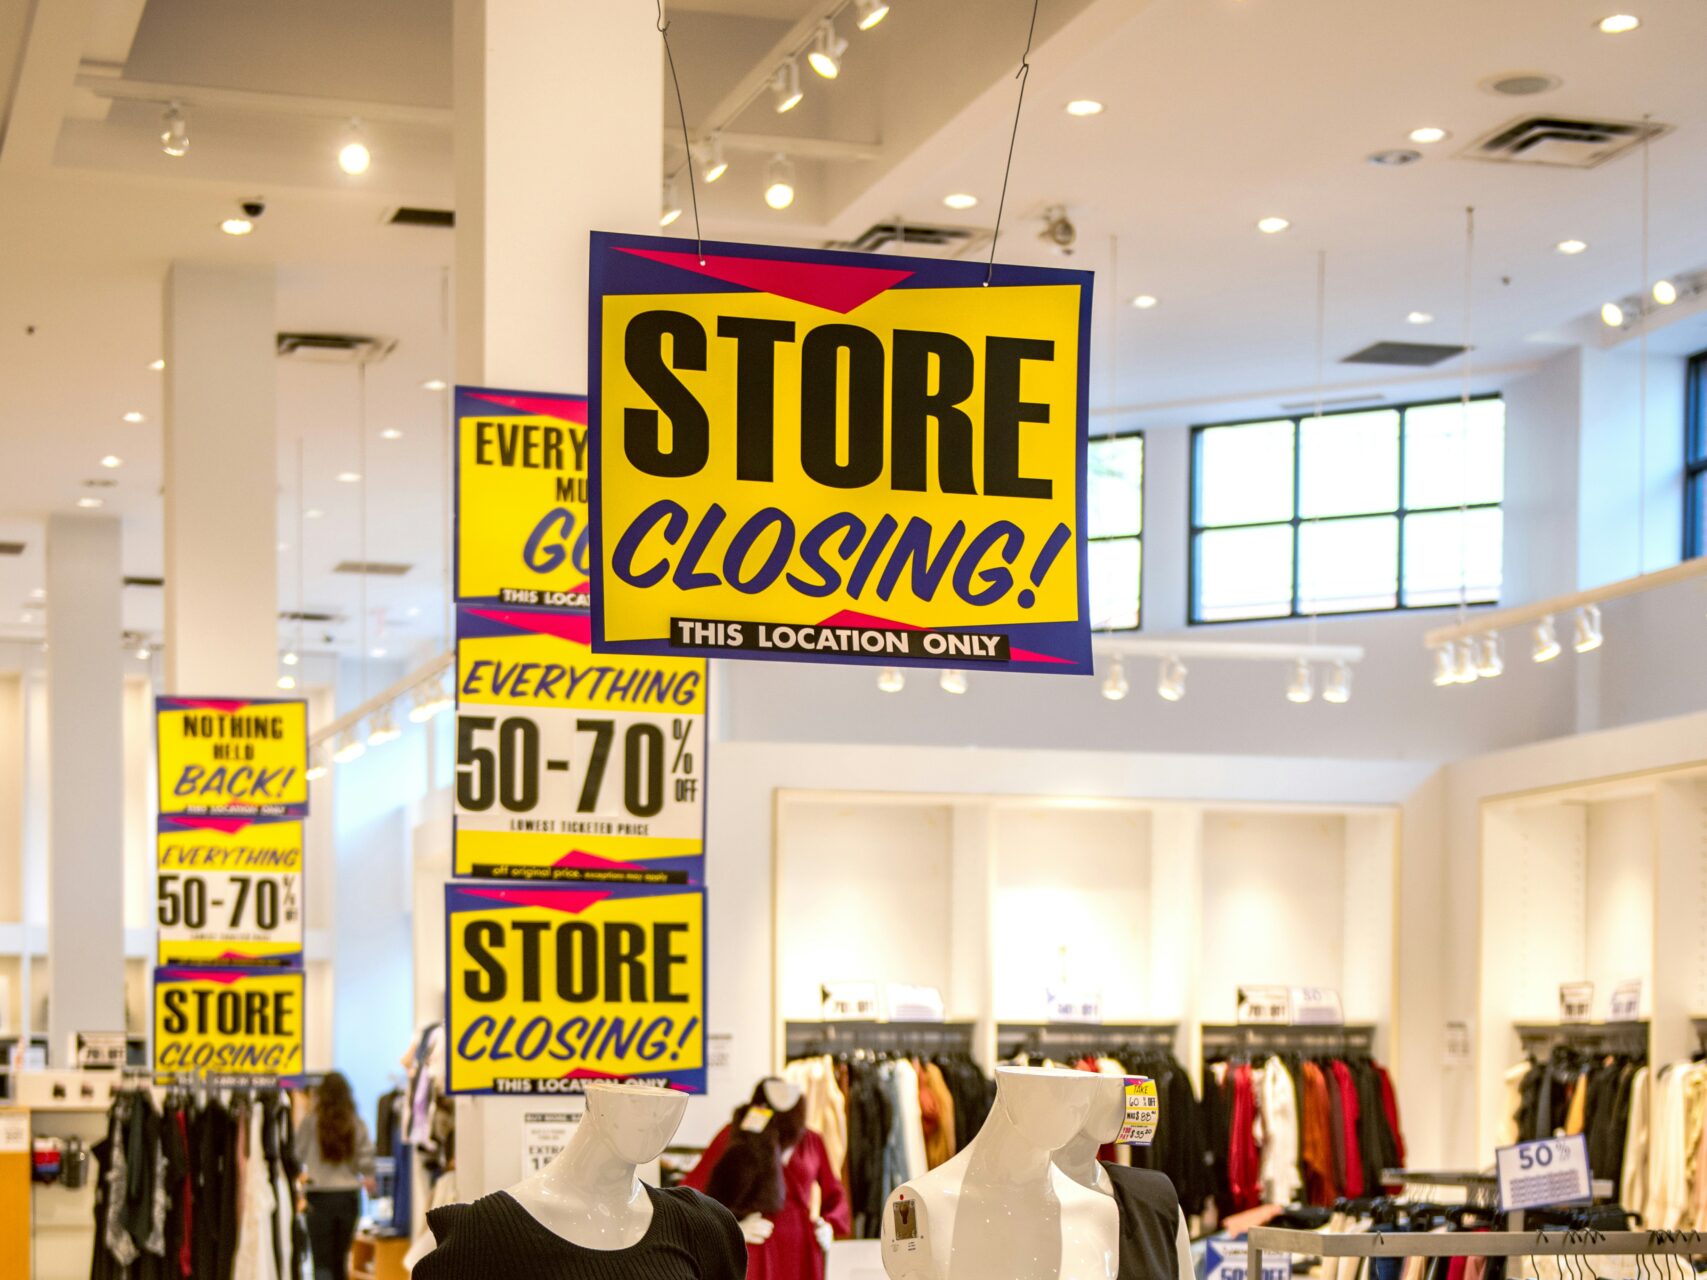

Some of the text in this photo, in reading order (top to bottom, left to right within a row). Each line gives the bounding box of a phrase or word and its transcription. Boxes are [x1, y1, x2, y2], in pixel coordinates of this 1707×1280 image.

[624, 309, 1055, 500] STORE
[611, 499, 1072, 610] CLOSING!
[503, 589, 538, 604] THIS
[678, 621, 1000, 657] THIS LOCATION ONLY
[462, 660, 700, 706] EVERYTHING
[183, 715, 283, 740] NOTHING
[173, 764, 296, 798] BACK!
[675, 778, 697, 802] OFF
[511, 819, 649, 836] LOWEST TICKETED PRICE
[162, 845, 299, 868] EVERYTHING
[511, 866, 551, 879] original
[464, 920, 688, 1003] STORE
[163, 988, 294, 1036] STORE
[457, 1015, 699, 1061] CLOSING!
[159, 1042, 300, 1068] CLOSING!
[496, 1079, 531, 1092] THIS
